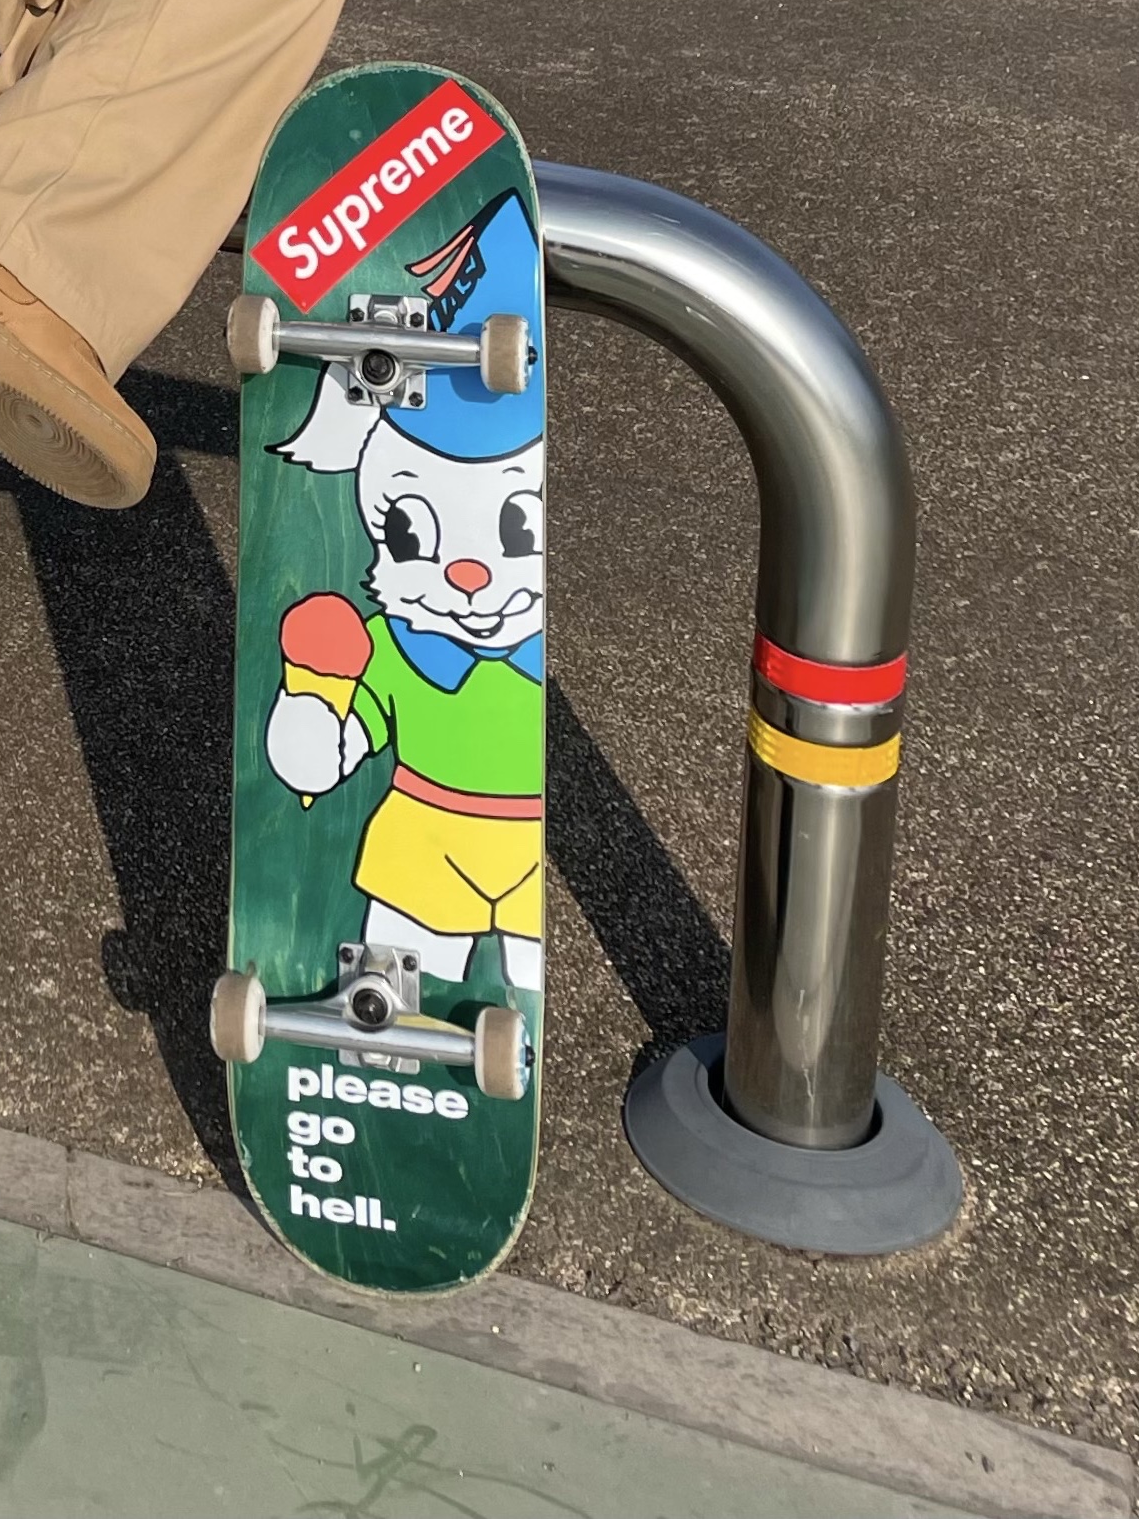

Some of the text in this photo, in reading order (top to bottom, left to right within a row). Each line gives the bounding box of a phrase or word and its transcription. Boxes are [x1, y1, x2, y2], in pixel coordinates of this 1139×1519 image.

[277, 106, 474, 280] Supreme
[287, 1063, 469, 1119] please
[287, 1111, 356, 1146] go
[286, 1145, 343, 1183] to
[290, 1184, 397, 1232] hell.
